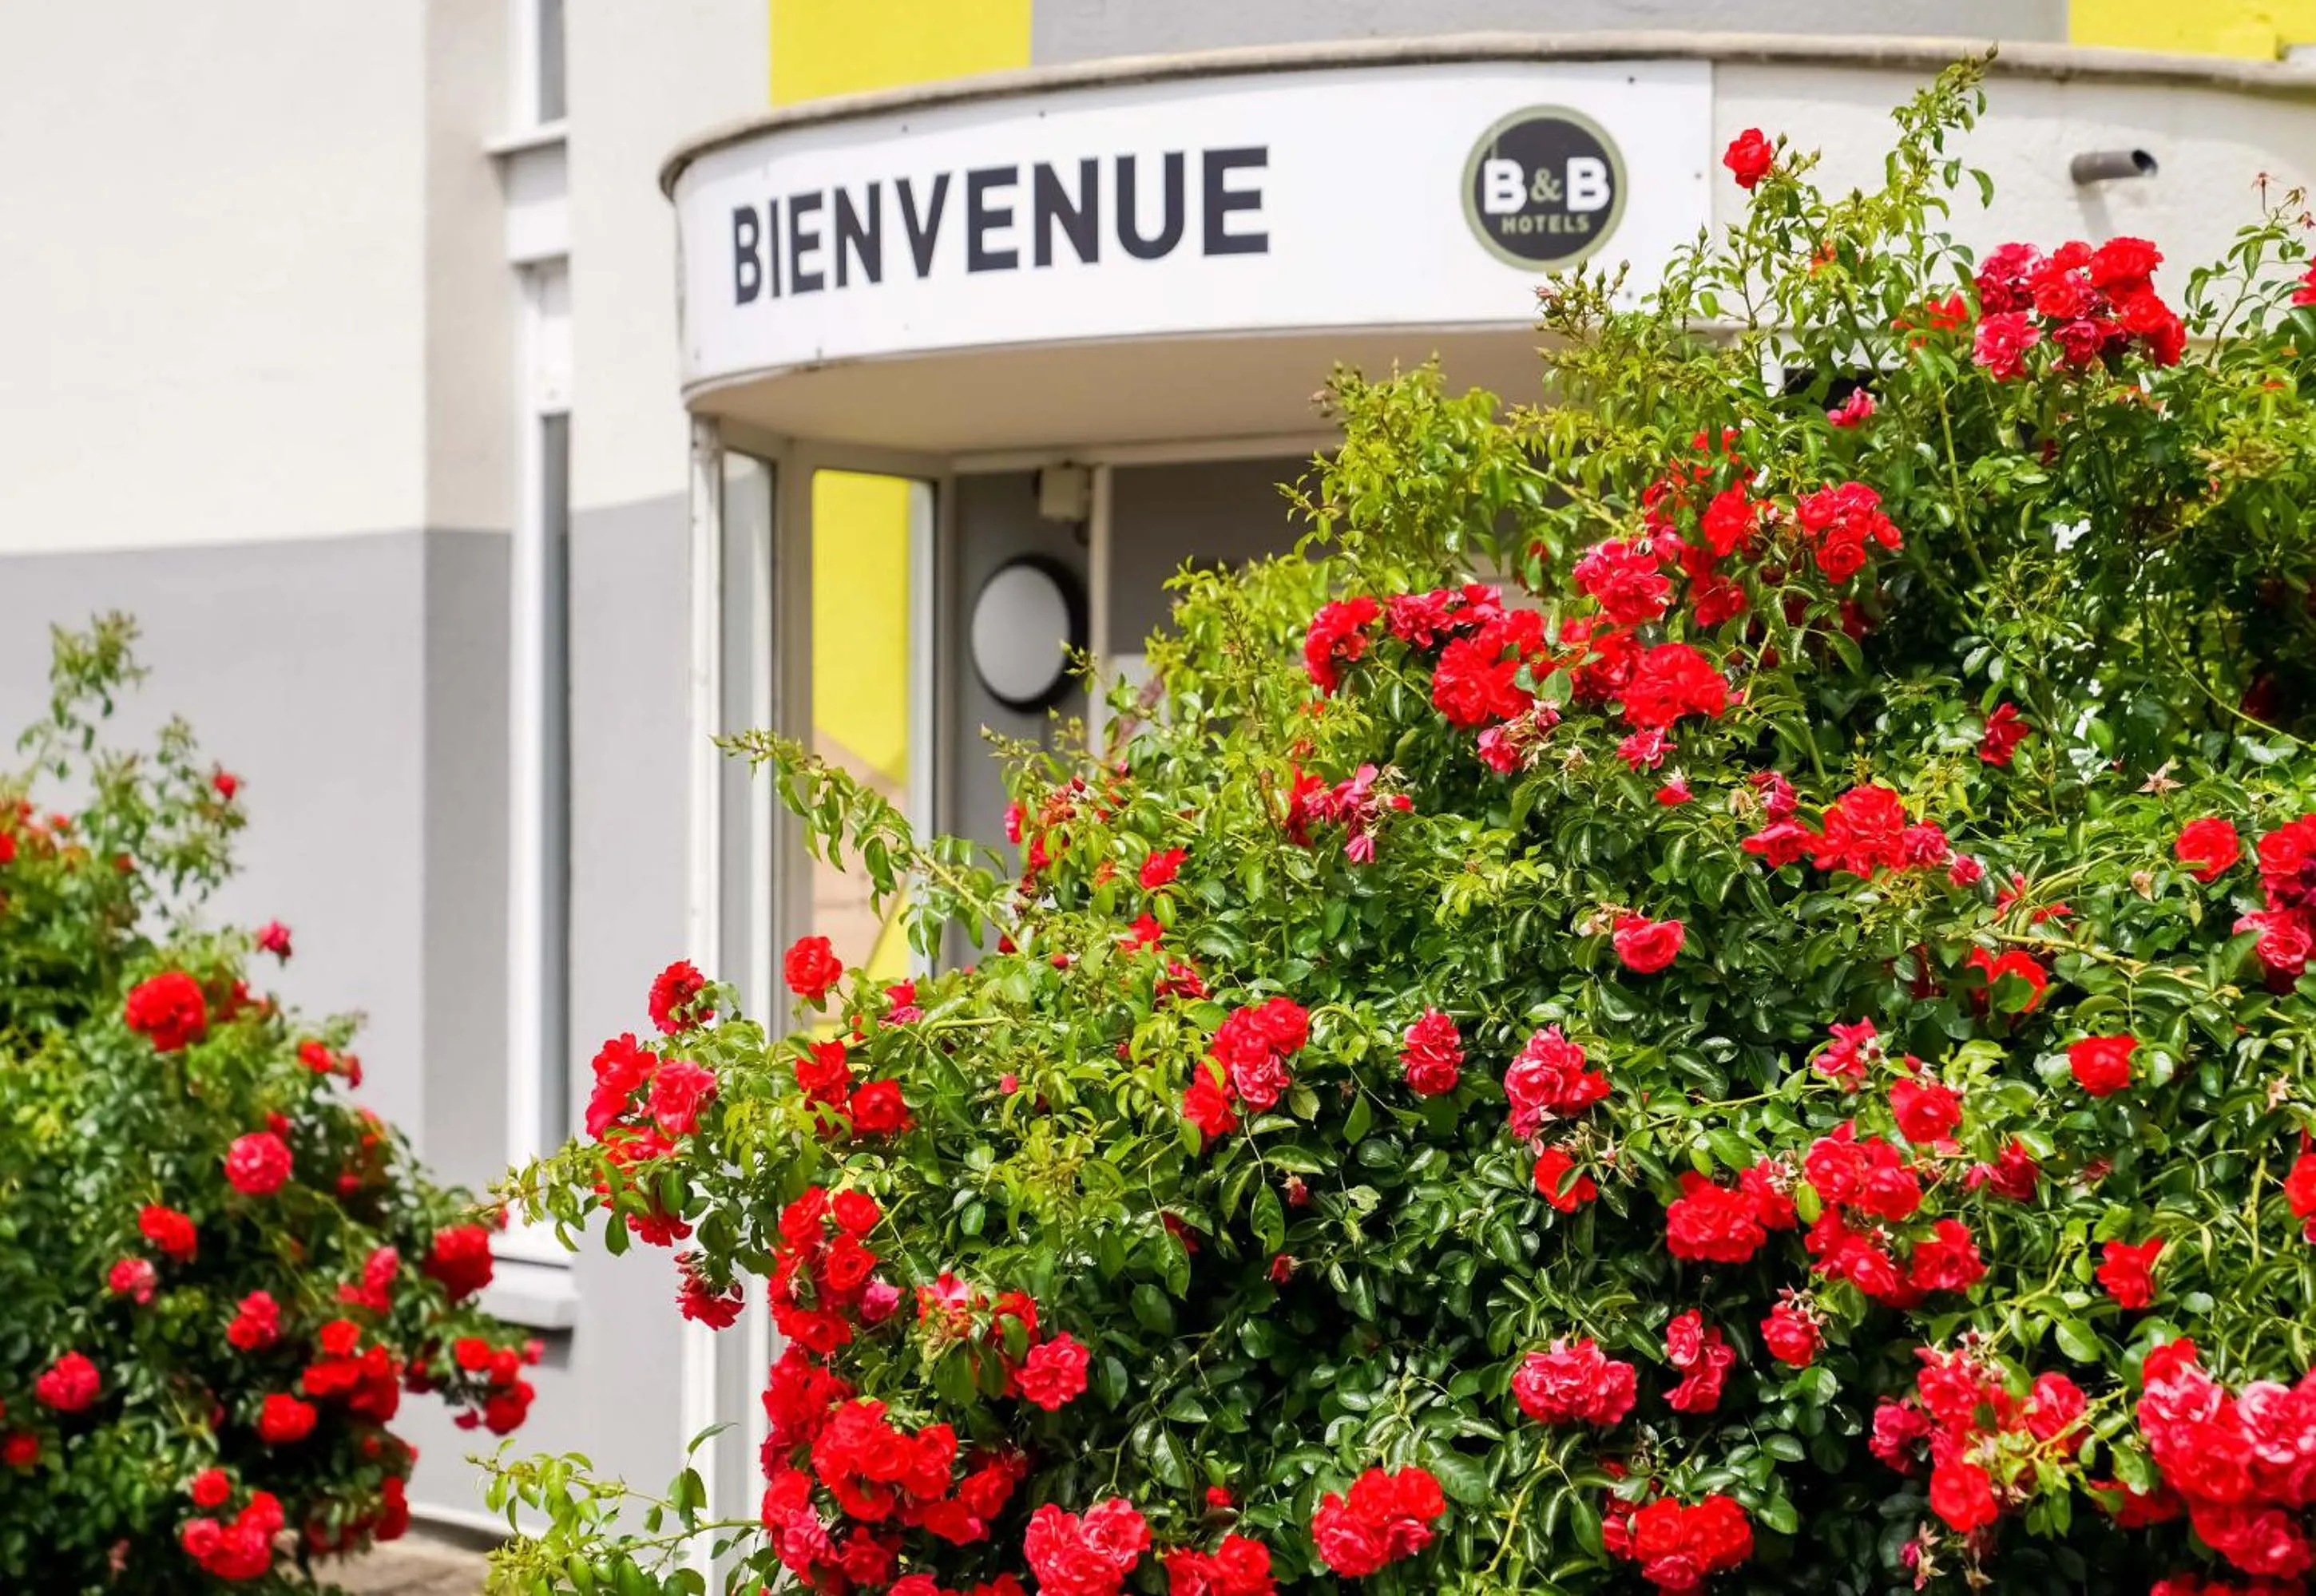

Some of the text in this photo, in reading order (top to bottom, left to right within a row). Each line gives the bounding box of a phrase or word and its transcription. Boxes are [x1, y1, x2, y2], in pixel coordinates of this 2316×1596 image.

[1483, 156, 1611, 214] B&B
[732, 145, 1269, 305] BIENVENUE
[1501, 214, 1590, 235] HOTELS
